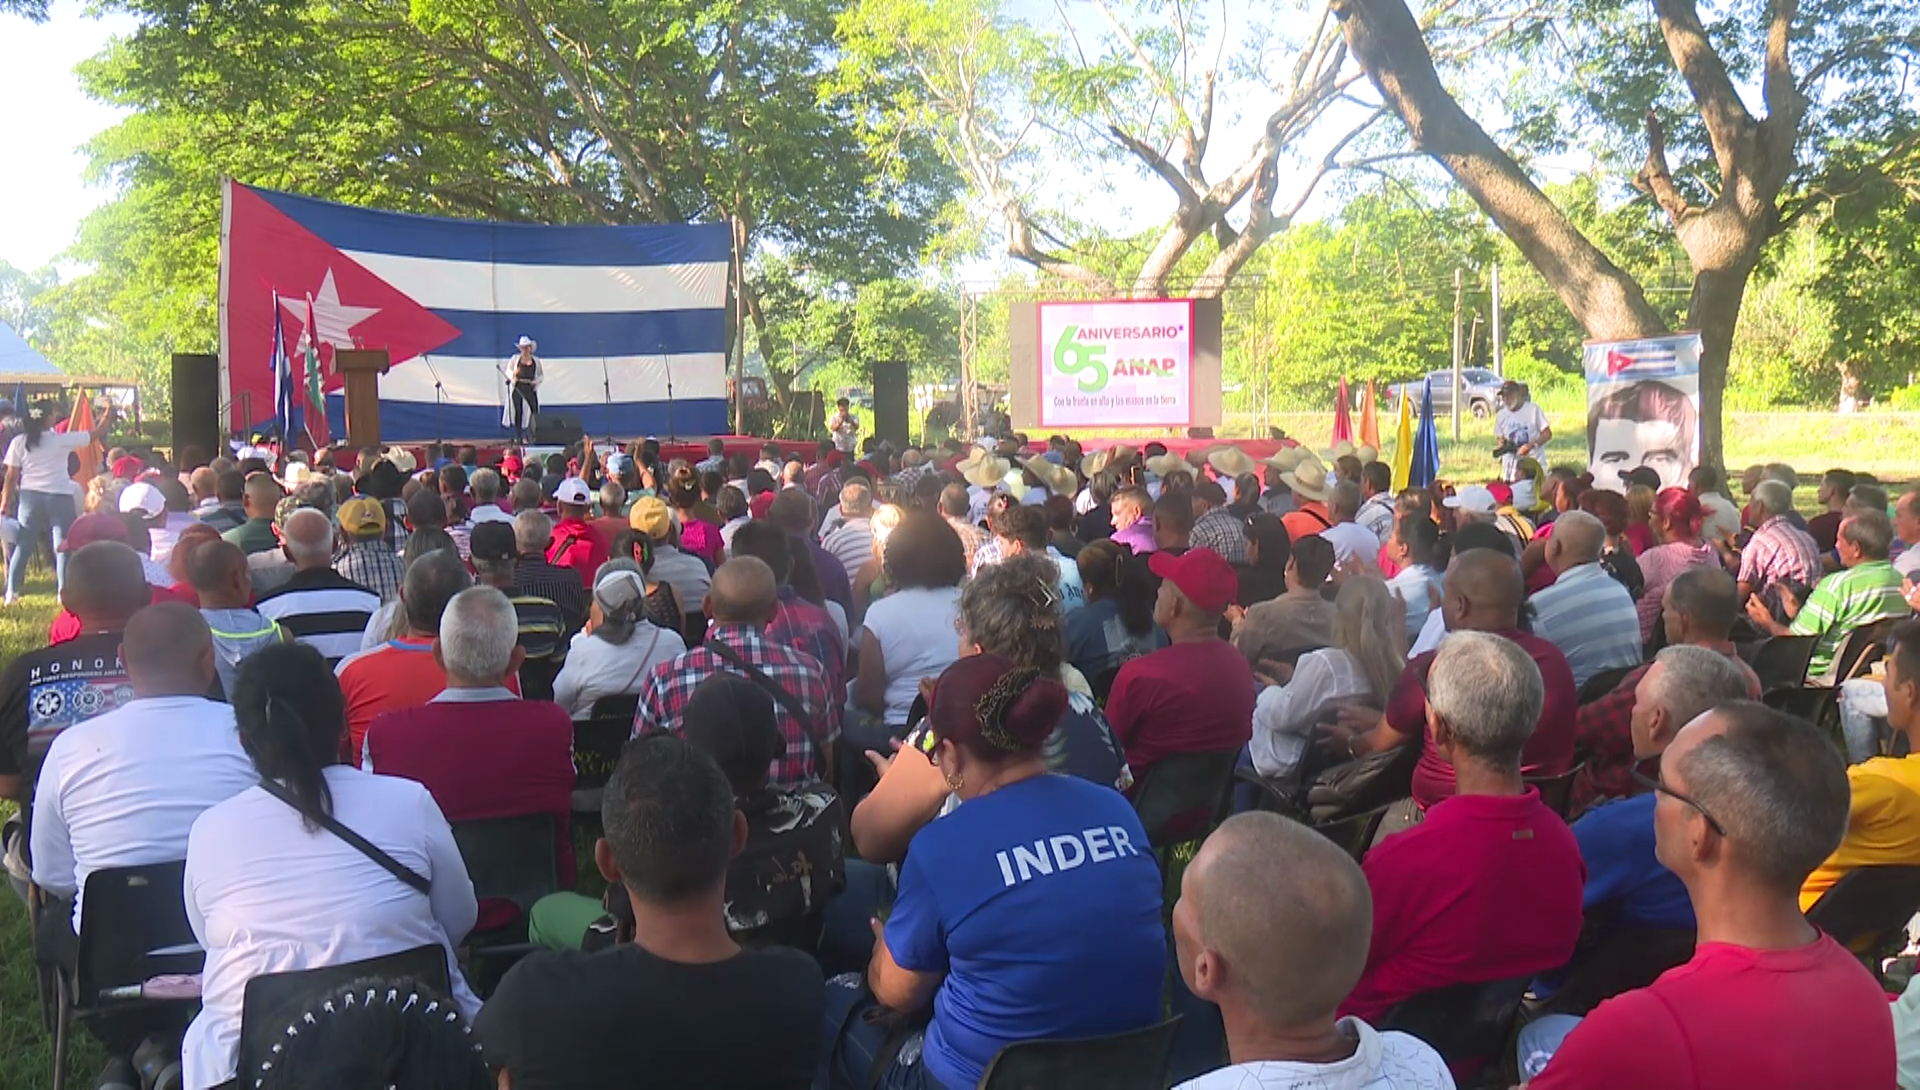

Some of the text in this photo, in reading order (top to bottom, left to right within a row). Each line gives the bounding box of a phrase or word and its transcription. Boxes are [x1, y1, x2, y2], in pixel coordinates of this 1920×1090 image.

[1077, 326, 1178, 340] ANIVERSARIO
[1053, 324, 1109, 393] 65
[1112, 357, 1176, 377] ANAP
[1053, 396, 1065, 407] Con
[1065, 395, 1072, 407] la
[996, 826, 1139, 887] INDER
